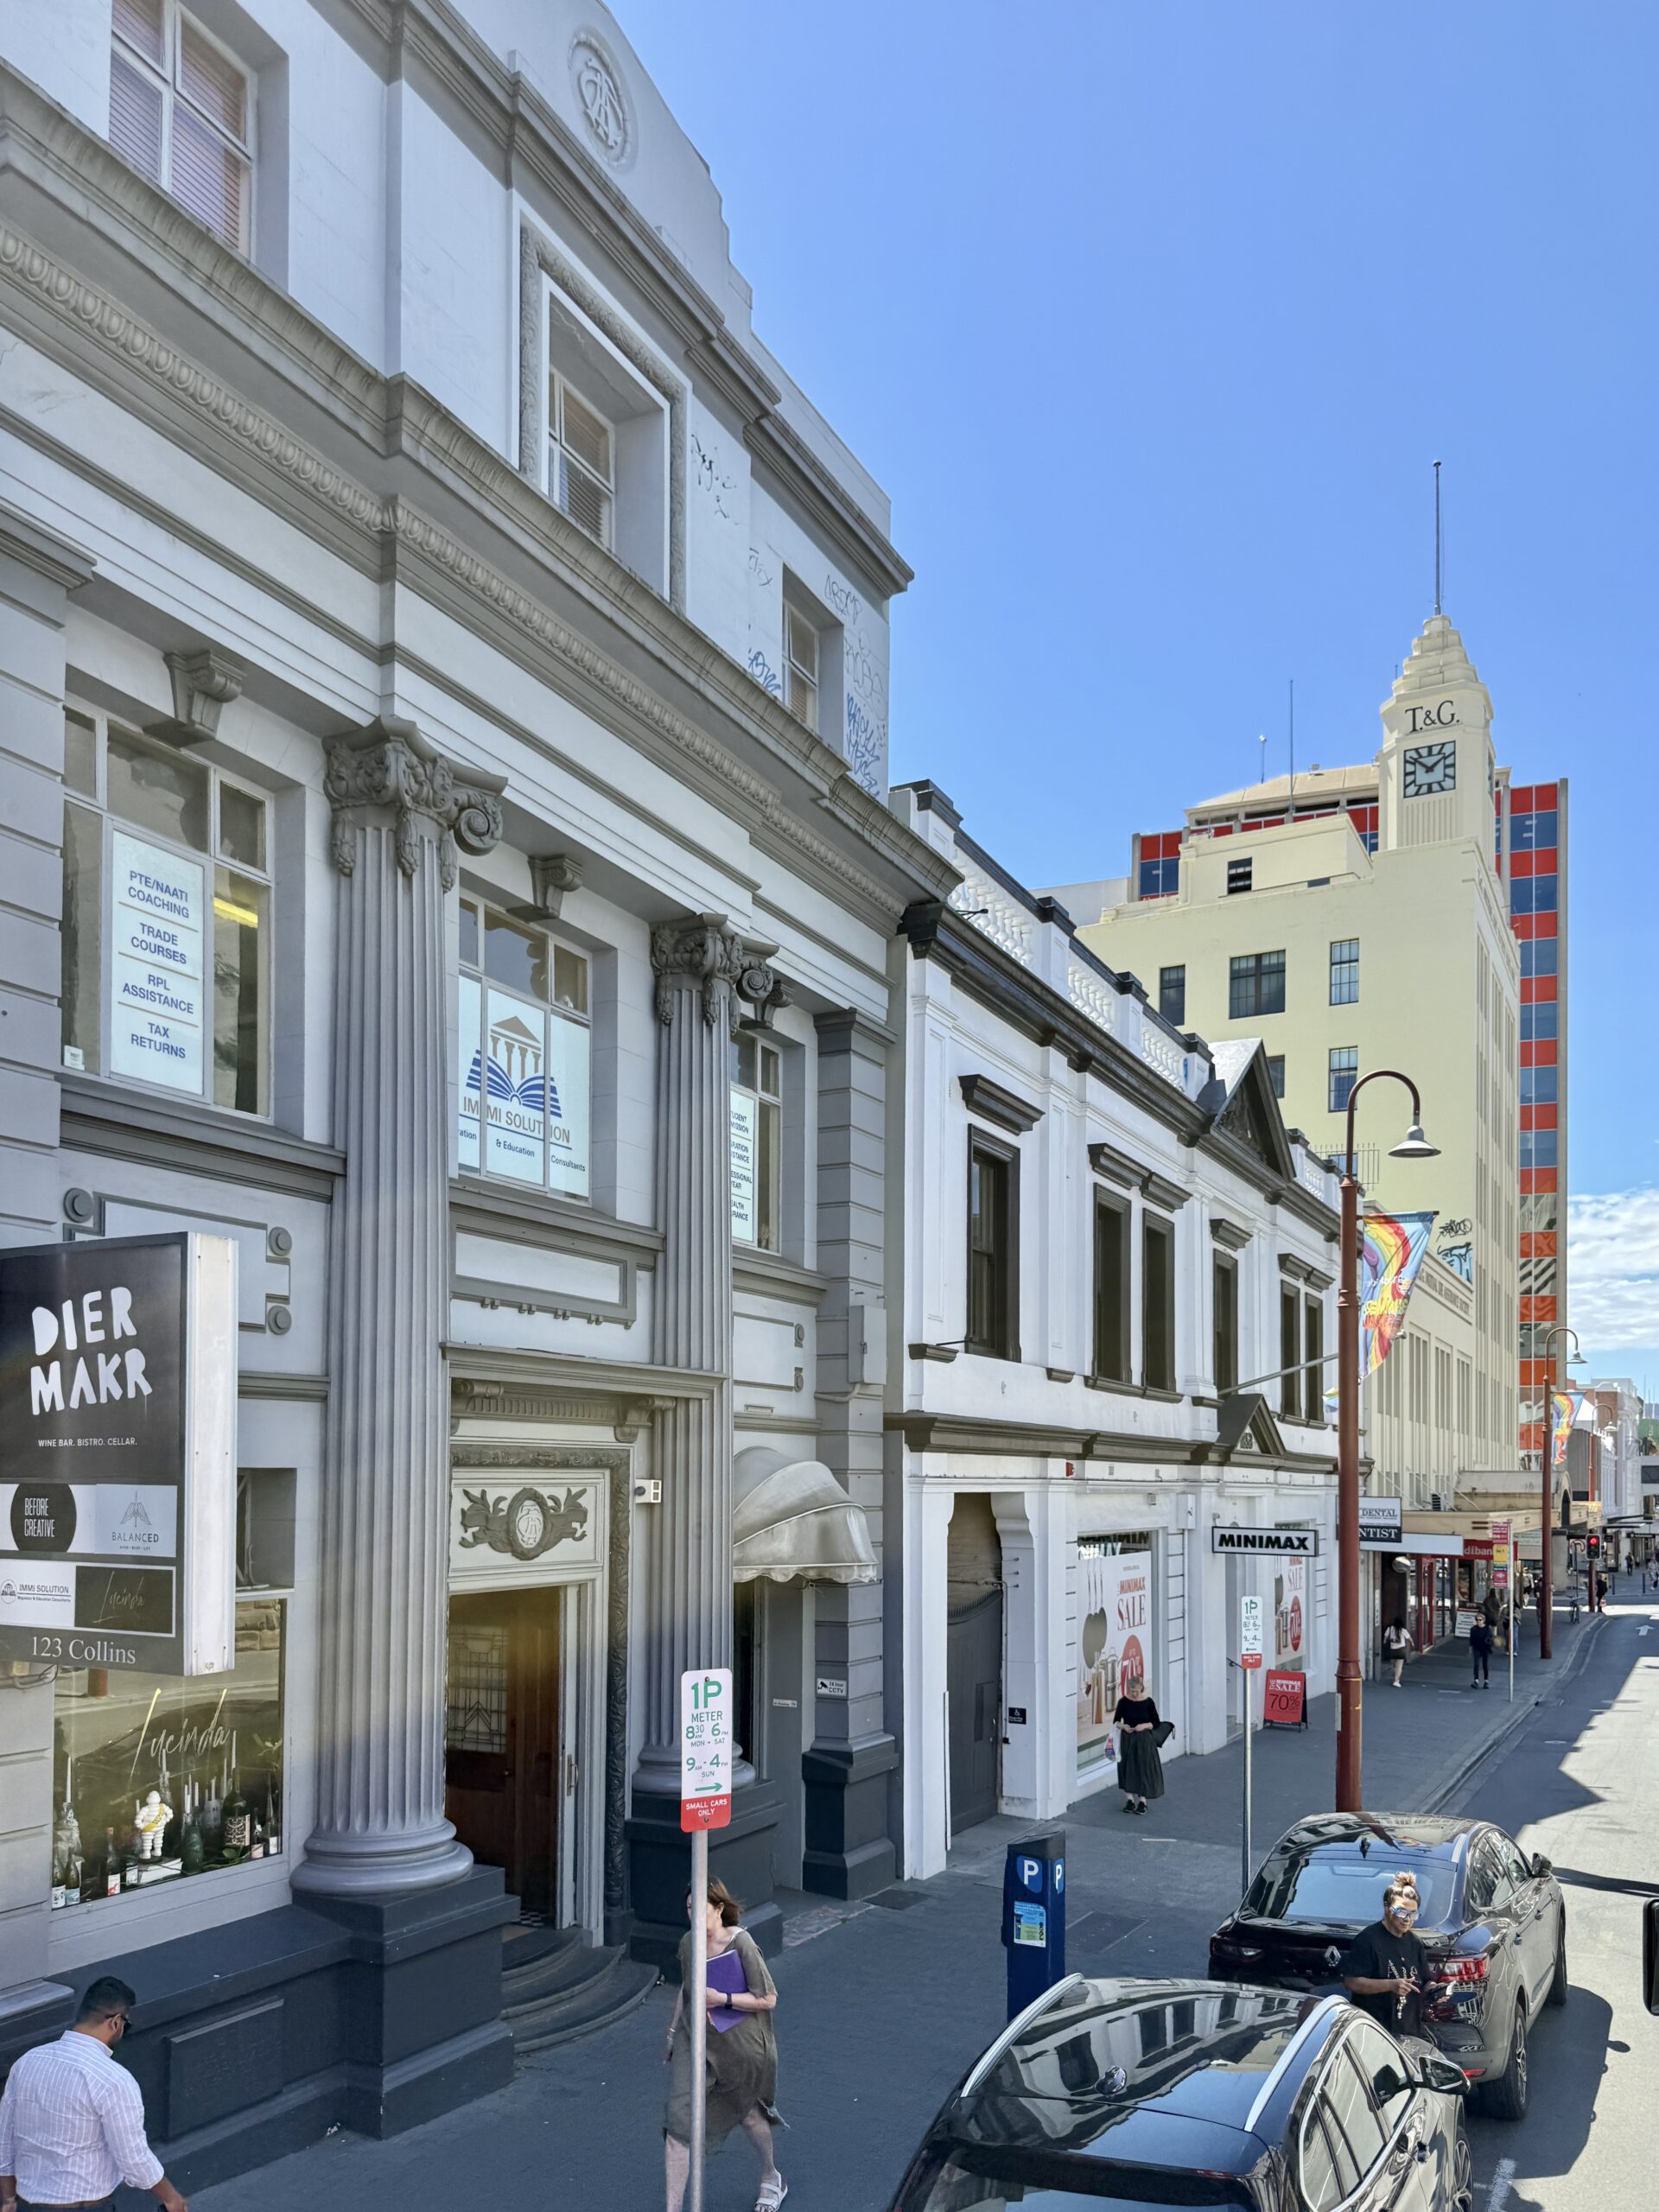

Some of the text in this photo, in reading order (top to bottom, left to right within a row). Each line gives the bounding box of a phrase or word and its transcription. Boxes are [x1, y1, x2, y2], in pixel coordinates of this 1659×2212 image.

[130, 870, 188, 903] PTE/NAATI
[128, 887, 190, 918] COACHING
[140, 923, 178, 946] TRADE
[131, 937, 187, 964] COURSES
[148, 974, 170, 991] RPL
[123, 982, 194, 1014] ASSISTANCE
[148, 1022, 169, 1039] TAX
[131, 1033, 186, 1058] RETURNS
[463, 1096, 570, 1144] IMMI SOLUTION
[496, 1138, 501, 1147] &
[503, 1140, 535, 1158] Education
[551, 1154, 586, 1172] Consultants
[31, 1287, 137, 1356] DIER
[30, 1348, 153, 1415] MAKR
[38, 1439, 57, 1447] WINE
[78, 1438, 105, 1446] BISTRO.
[108, 1437, 137, 1446] CELLAR.
[25, 1498, 49, 1516] BEFORE
[1362, 1508, 1398, 1517] DENTAL
[24, 1519, 55, 1537] CREATIVE
[111, 1532, 159, 1542] BALANCED
[1359, 1528, 1398, 1538] NTIST
[1218, 1534, 1309, 1550] MINIMAX
[1464, 1546, 1492, 1555] diban
[36, 1585, 69, 1593] SOLUTION
[1117, 1594, 1147, 1631] SALE
[1245, 1599, 1258, 1614] 1P
[32, 1637, 136, 1665] 123 Collins
[691, 1681, 721, 1709] 1P
[1275, 1683, 1300, 1693] SALE
[1268, 1694, 1300, 1710] 70%
[691, 1711, 722, 1723] METER
[711, 1723, 721, 1737] 6
[709, 1753, 720, 1768] 4
[685, 1798, 728, 1810] SMALL CARS
[698, 1808, 715, 1816] ONLY
[1023, 1859, 1039, 1885] P
[1055, 1864, 1063, 1891] P
